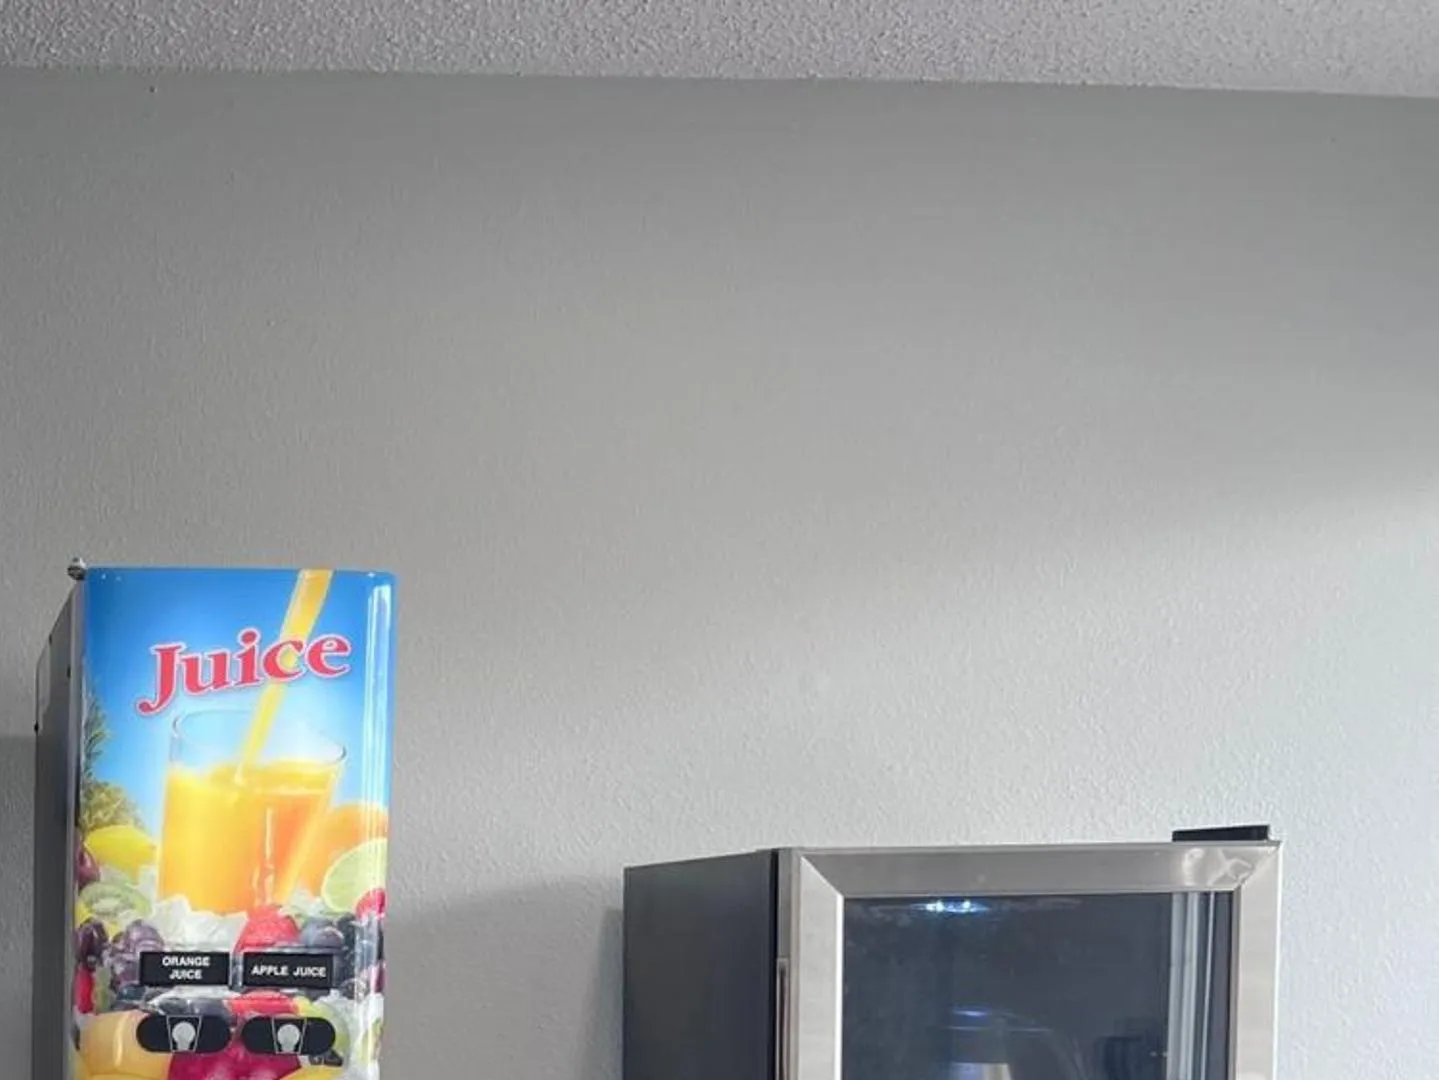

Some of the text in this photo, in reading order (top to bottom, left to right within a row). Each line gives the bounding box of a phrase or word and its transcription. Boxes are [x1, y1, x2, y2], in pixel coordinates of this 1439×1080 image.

[137, 628, 351, 717] Juice
[162, 956, 211, 968] ORANGE
[169, 968, 203, 980] JUICE
[251, 964, 327, 978] APPLE JUICE
